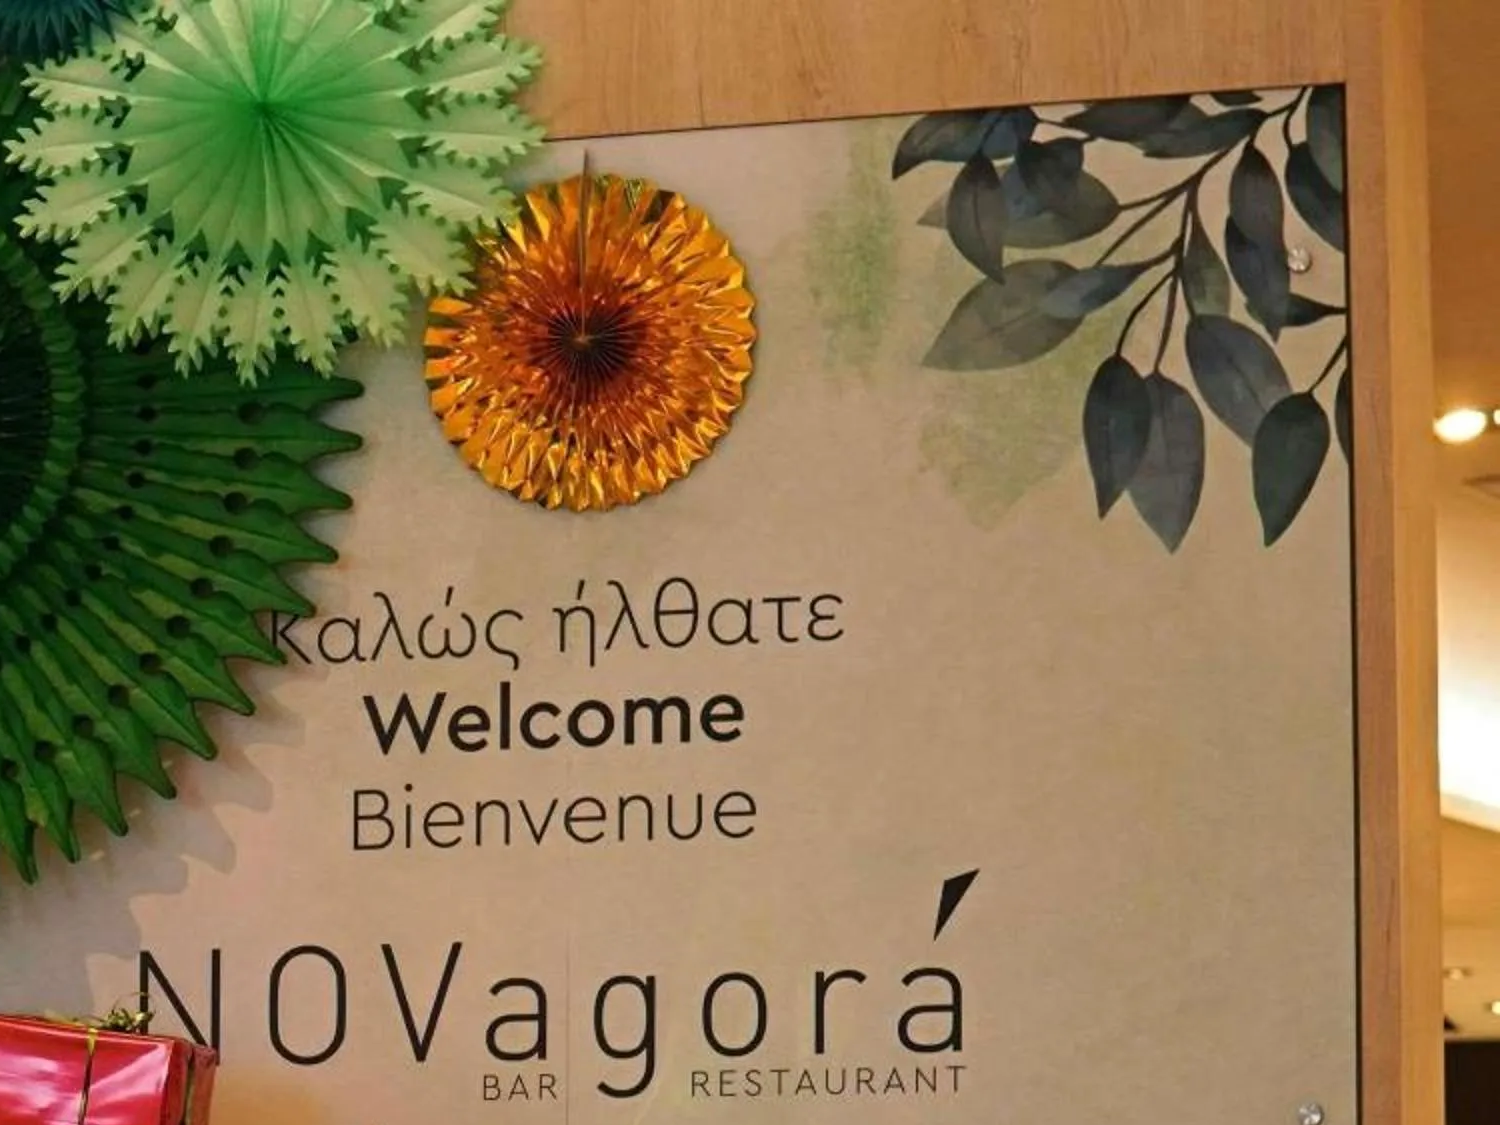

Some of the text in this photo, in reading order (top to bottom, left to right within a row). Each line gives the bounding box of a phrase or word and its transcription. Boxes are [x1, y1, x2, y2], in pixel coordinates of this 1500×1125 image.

[552, 577, 844, 667] ήλθατε
[362, 681, 745, 756] Welcome
[353, 783, 757, 851] Bienvenue
[483, 1065, 967, 1102] BAR RESTAURANT
